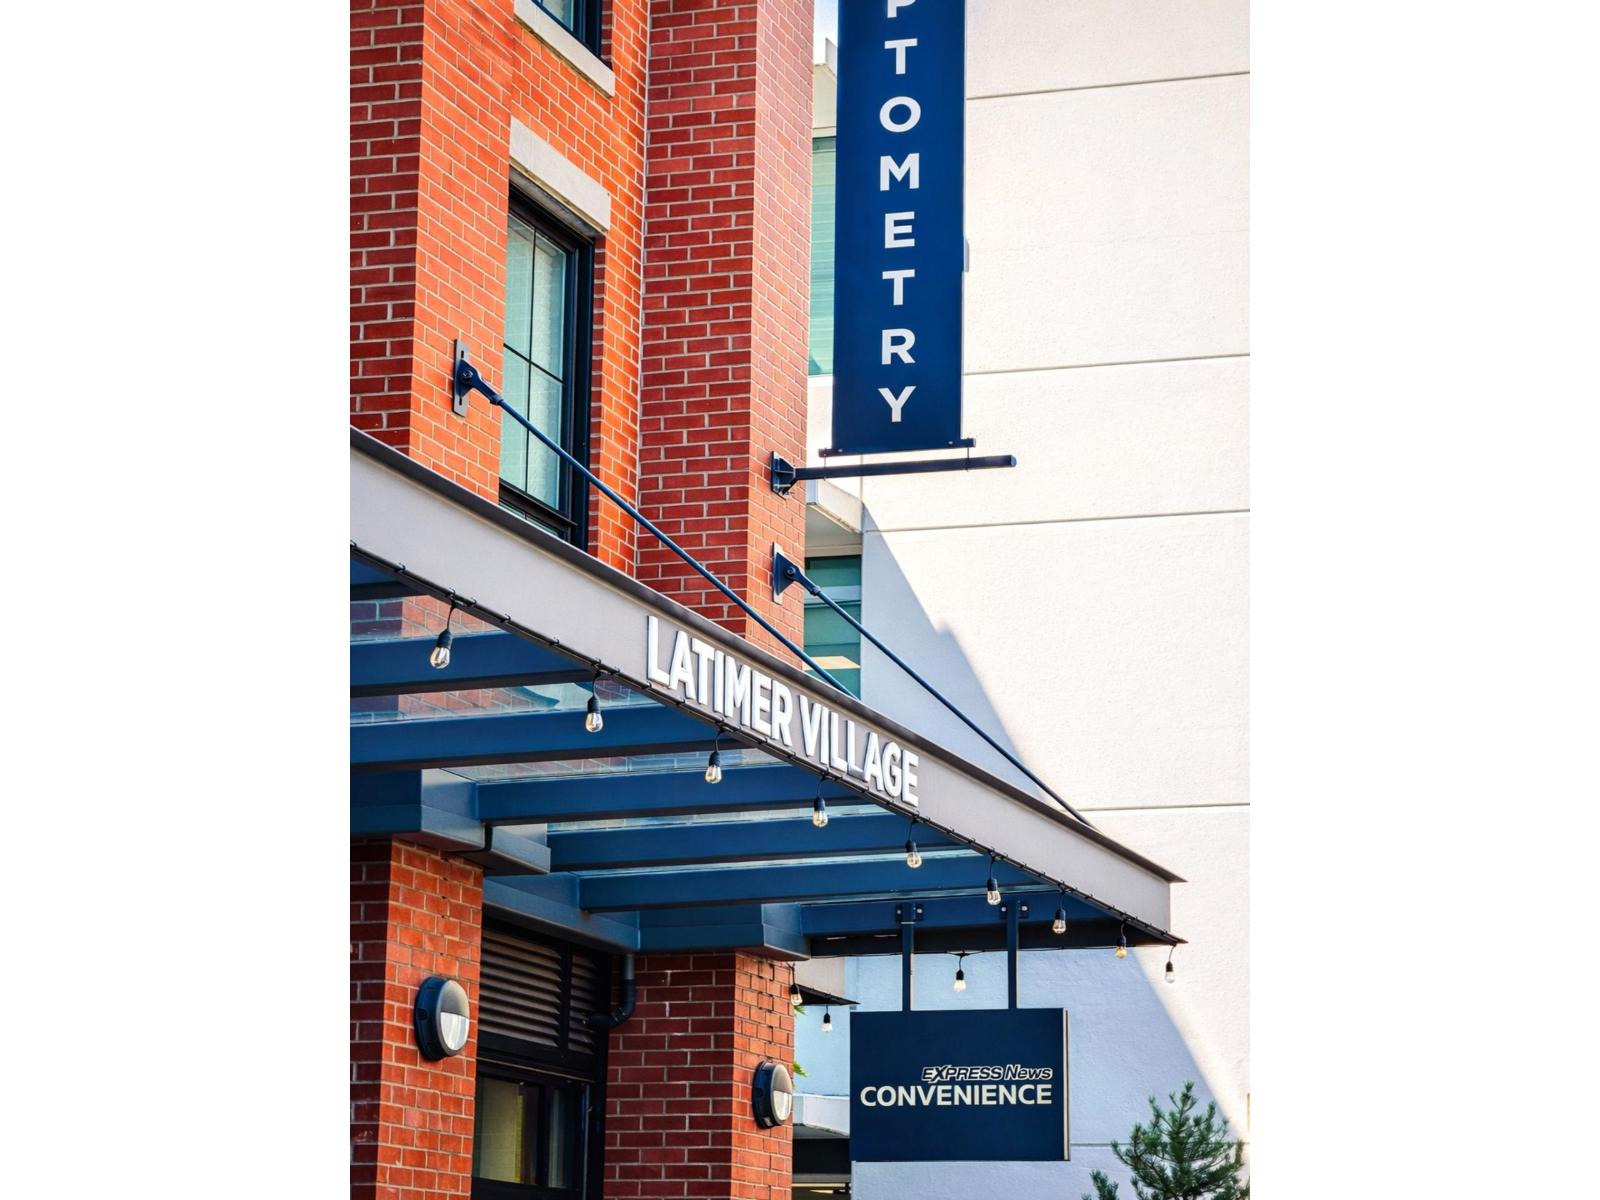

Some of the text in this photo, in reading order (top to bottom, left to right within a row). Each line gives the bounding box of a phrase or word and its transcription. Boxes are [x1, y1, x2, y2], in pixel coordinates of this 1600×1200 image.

[647, 615, 919, 808] LATIMER VILLAGE
[921, 1064, 1053, 1083] EXPRESS News
[860, 1084, 1053, 1107] CONVENIENCE
